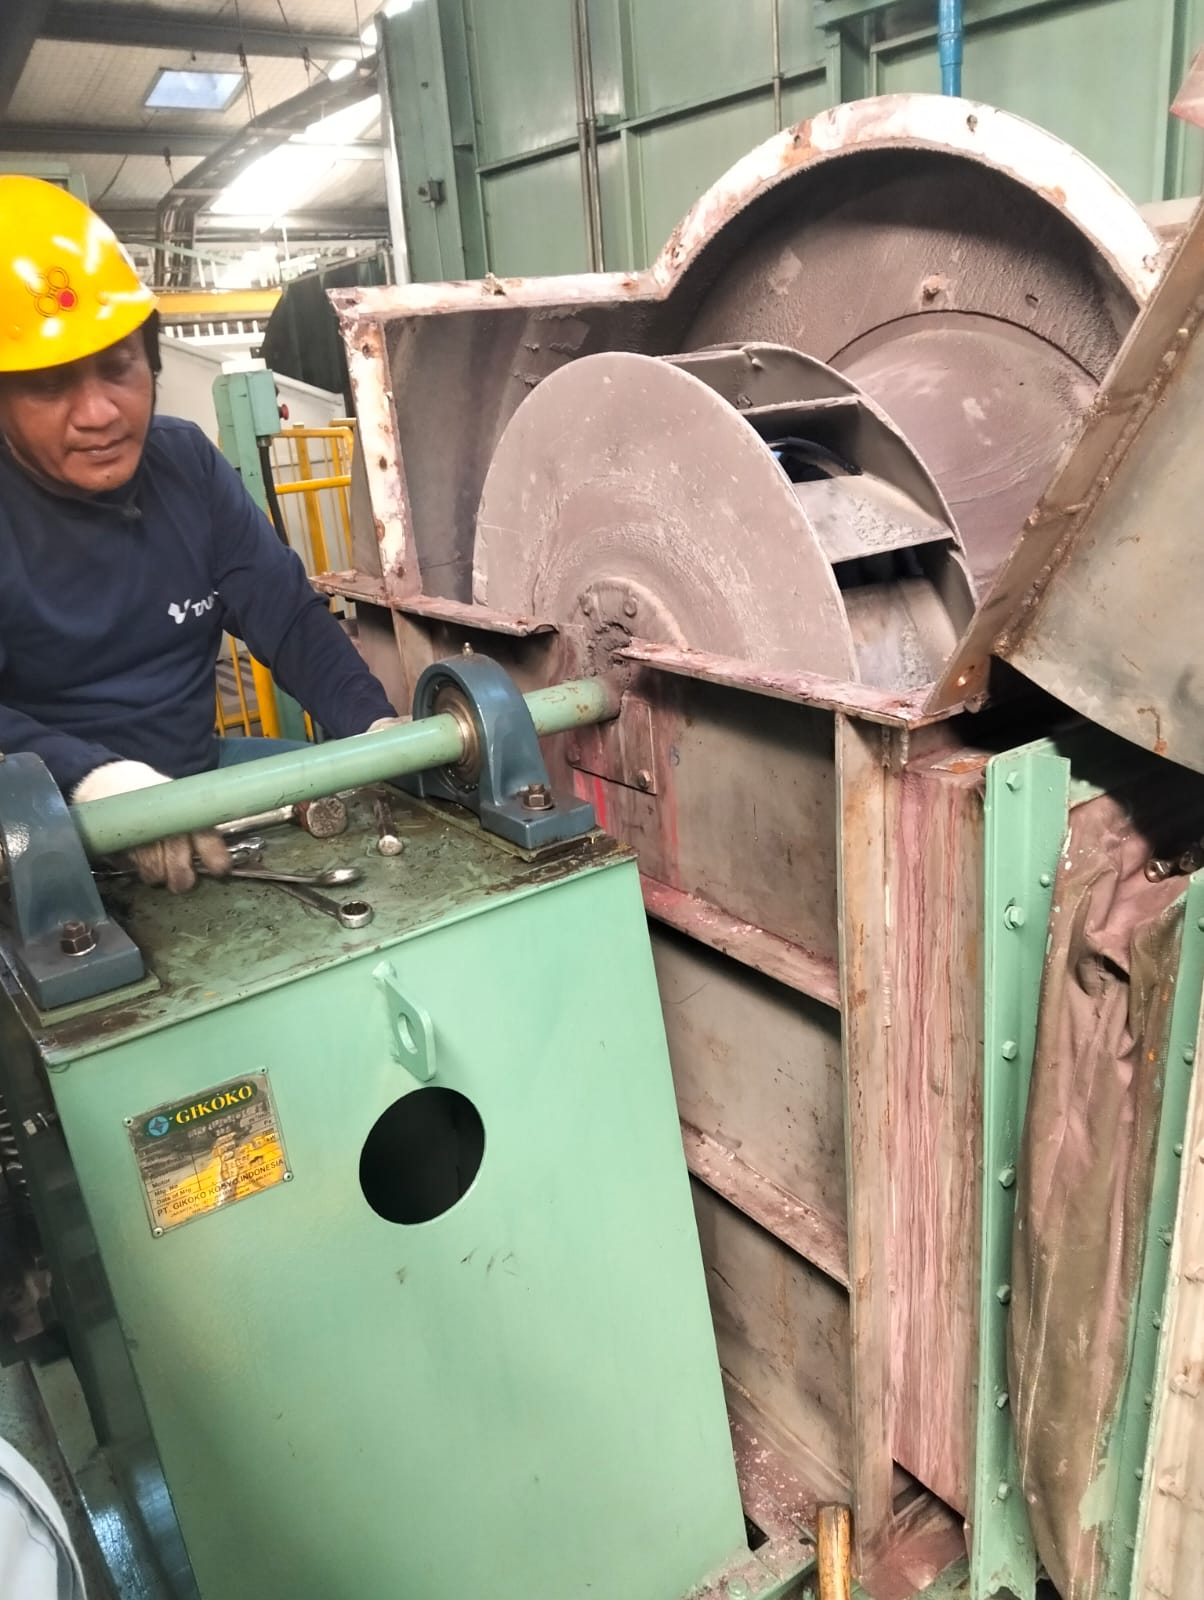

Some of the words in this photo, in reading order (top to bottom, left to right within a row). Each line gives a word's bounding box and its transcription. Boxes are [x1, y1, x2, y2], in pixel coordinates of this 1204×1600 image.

[175, 1085, 252, 1124] GIKOKO
[172, 1191, 207, 1211] GIKOKO
[240, 1159, 283, 1182] INDONESIA
